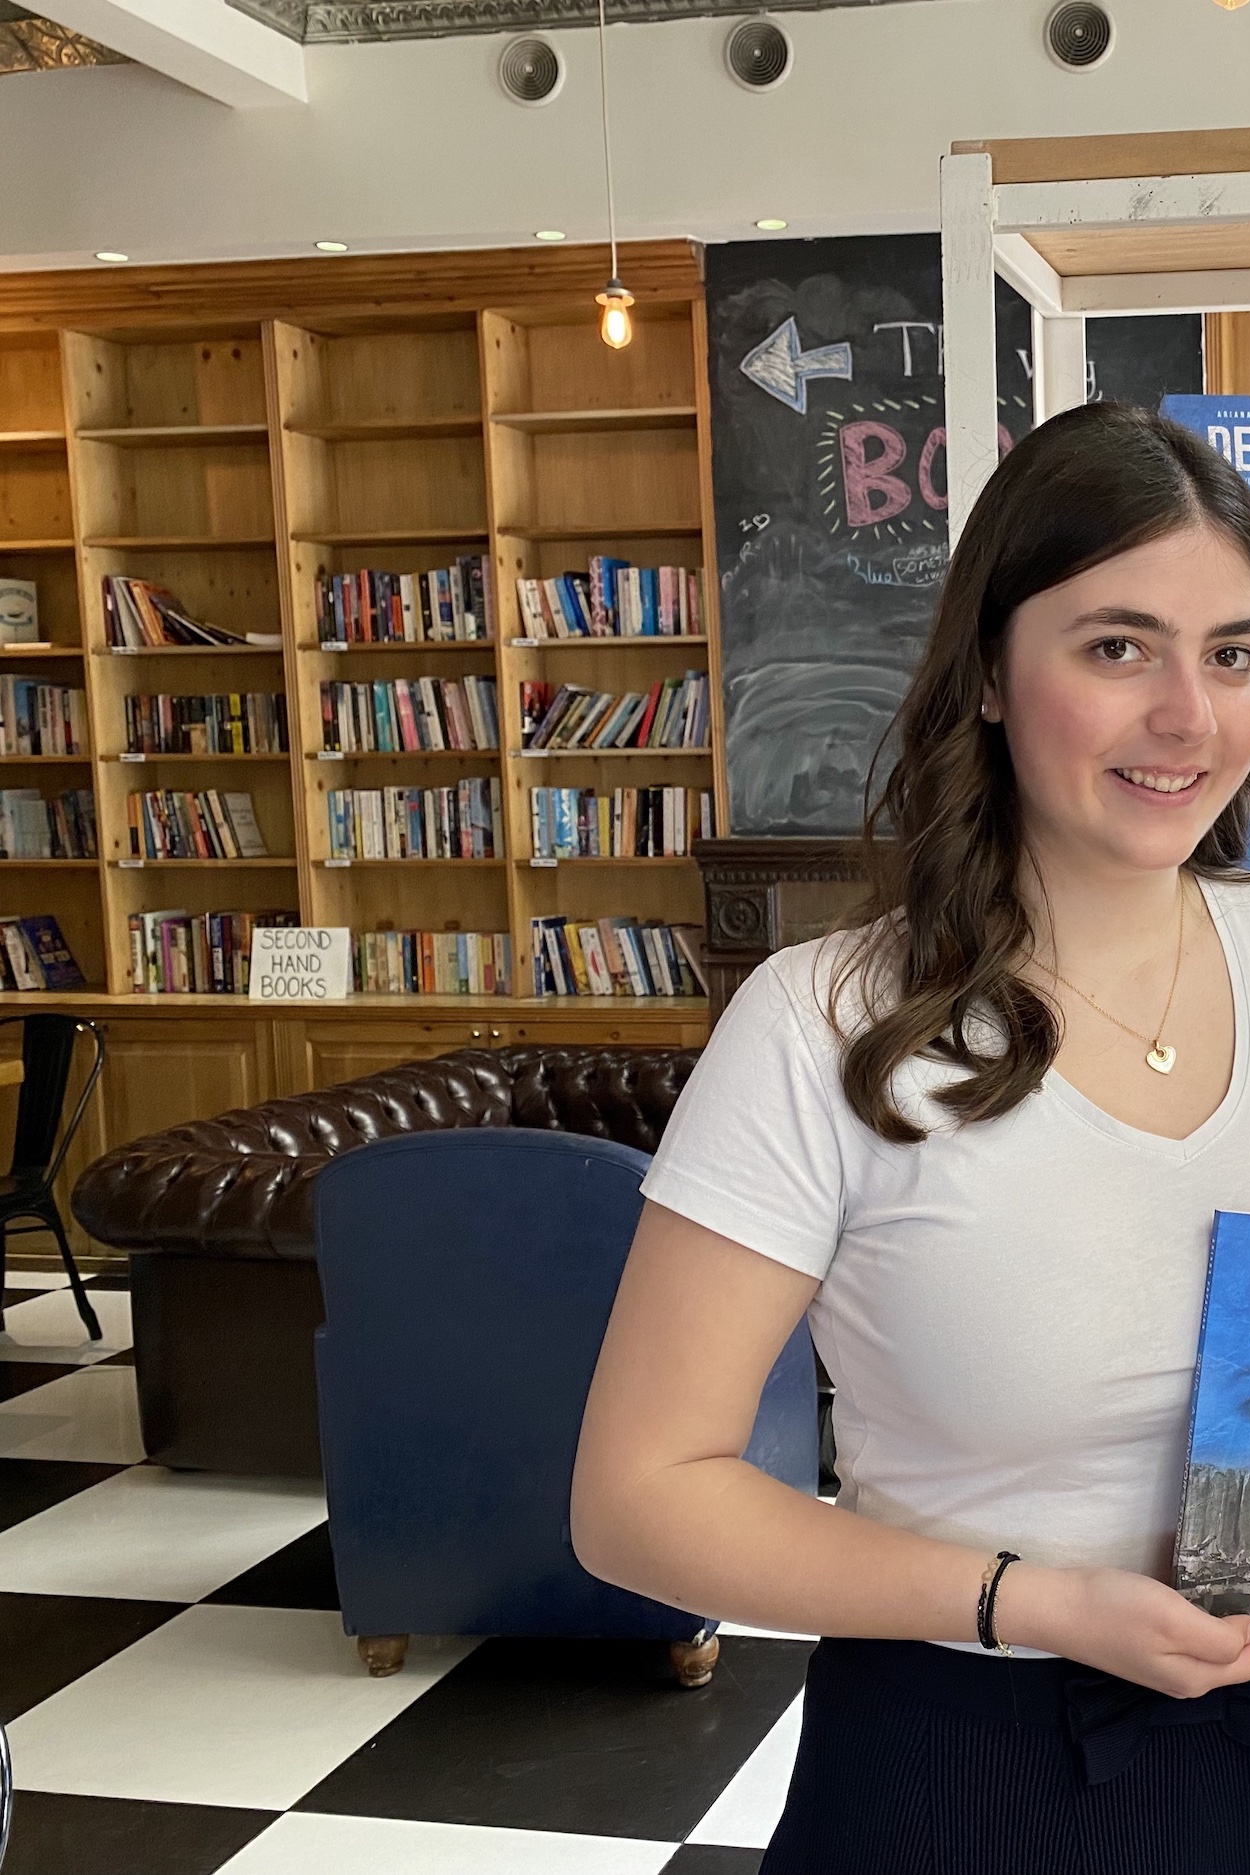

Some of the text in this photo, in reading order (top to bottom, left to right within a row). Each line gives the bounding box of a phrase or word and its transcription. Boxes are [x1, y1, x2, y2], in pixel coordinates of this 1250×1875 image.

[1216, 410, 1250, 419] ARIANA
[260, 929, 332, 950] SECOND
[271, 954, 322, 974] HAND
[260, 975, 327, 998] BOOKS
